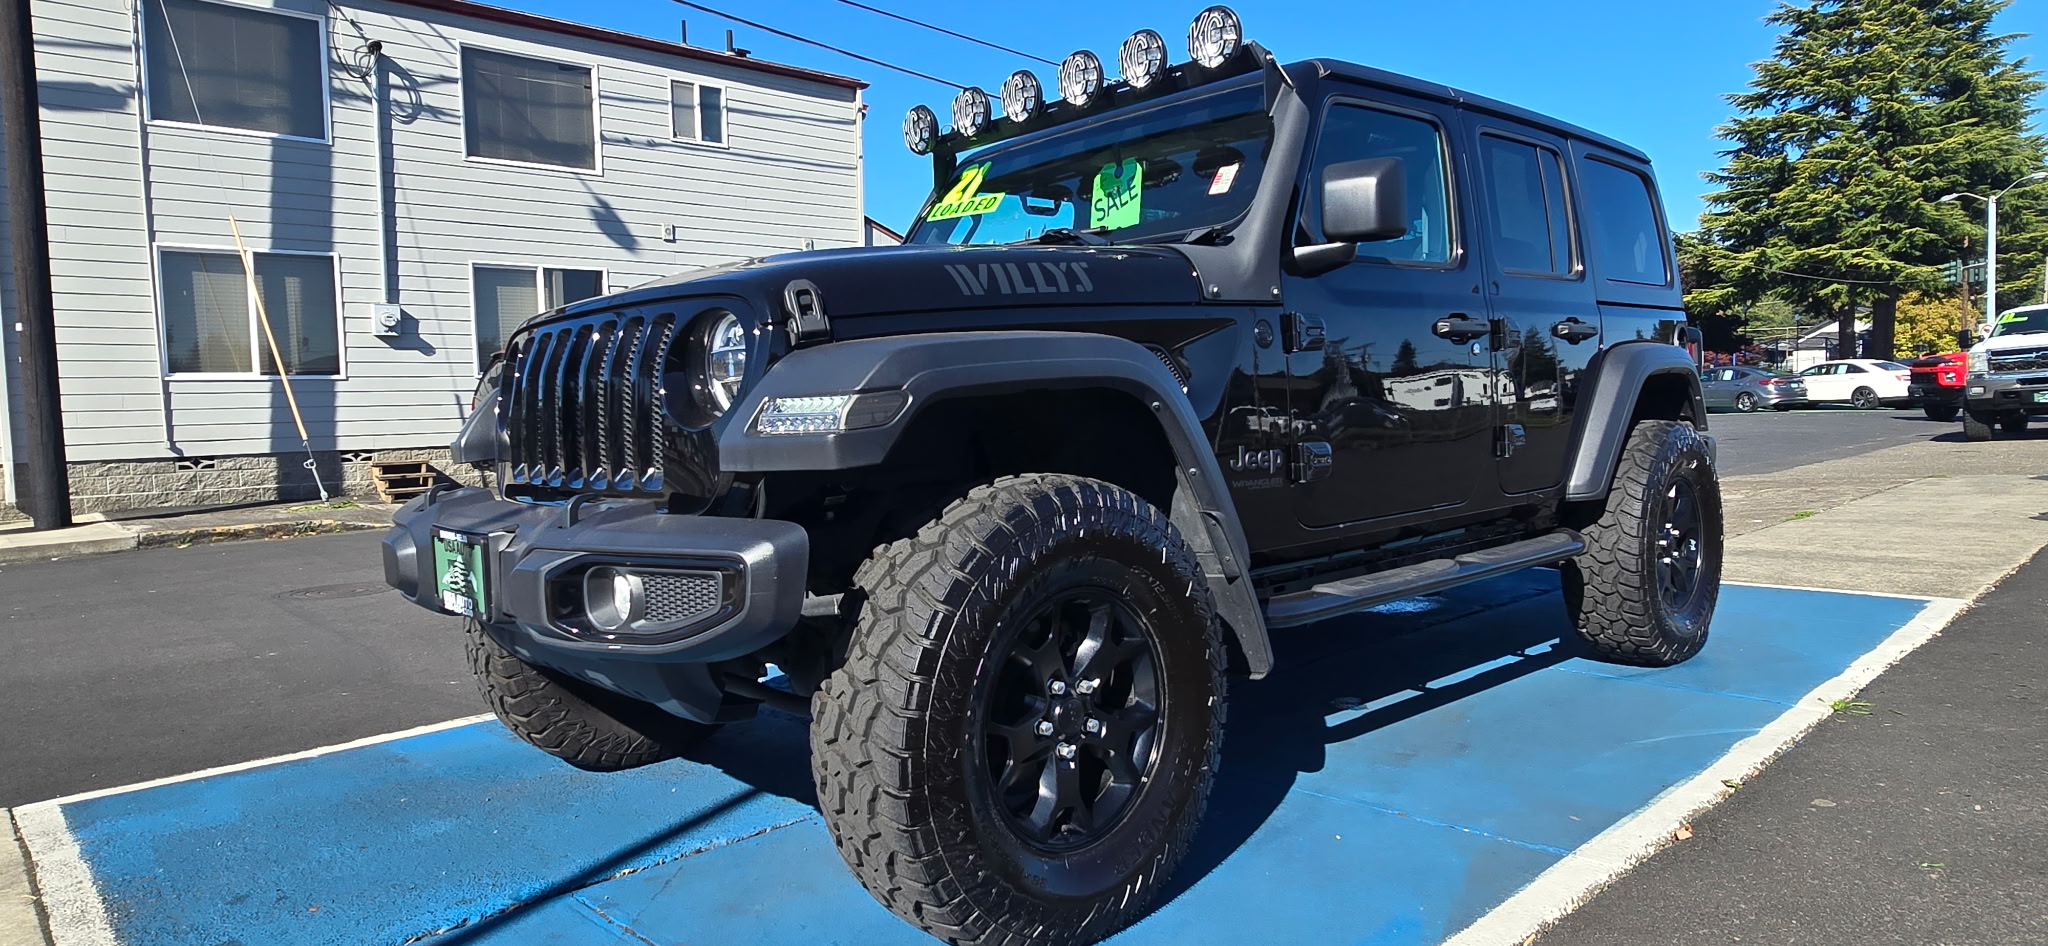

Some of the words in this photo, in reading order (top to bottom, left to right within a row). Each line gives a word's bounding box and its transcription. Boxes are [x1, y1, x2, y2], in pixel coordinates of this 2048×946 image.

[1119, 34, 1149, 82] KC
[1189, 11, 1224, 65] KC
[1001, 75, 1025, 118] KC
[1059, 55, 1086, 101] KC
[931, 196, 998, 218] LOADED
[1094, 184, 1138, 222] SALE
[944, 262, 1094, 296] WILLYS
[1230, 445, 1283, 474] Jeep
